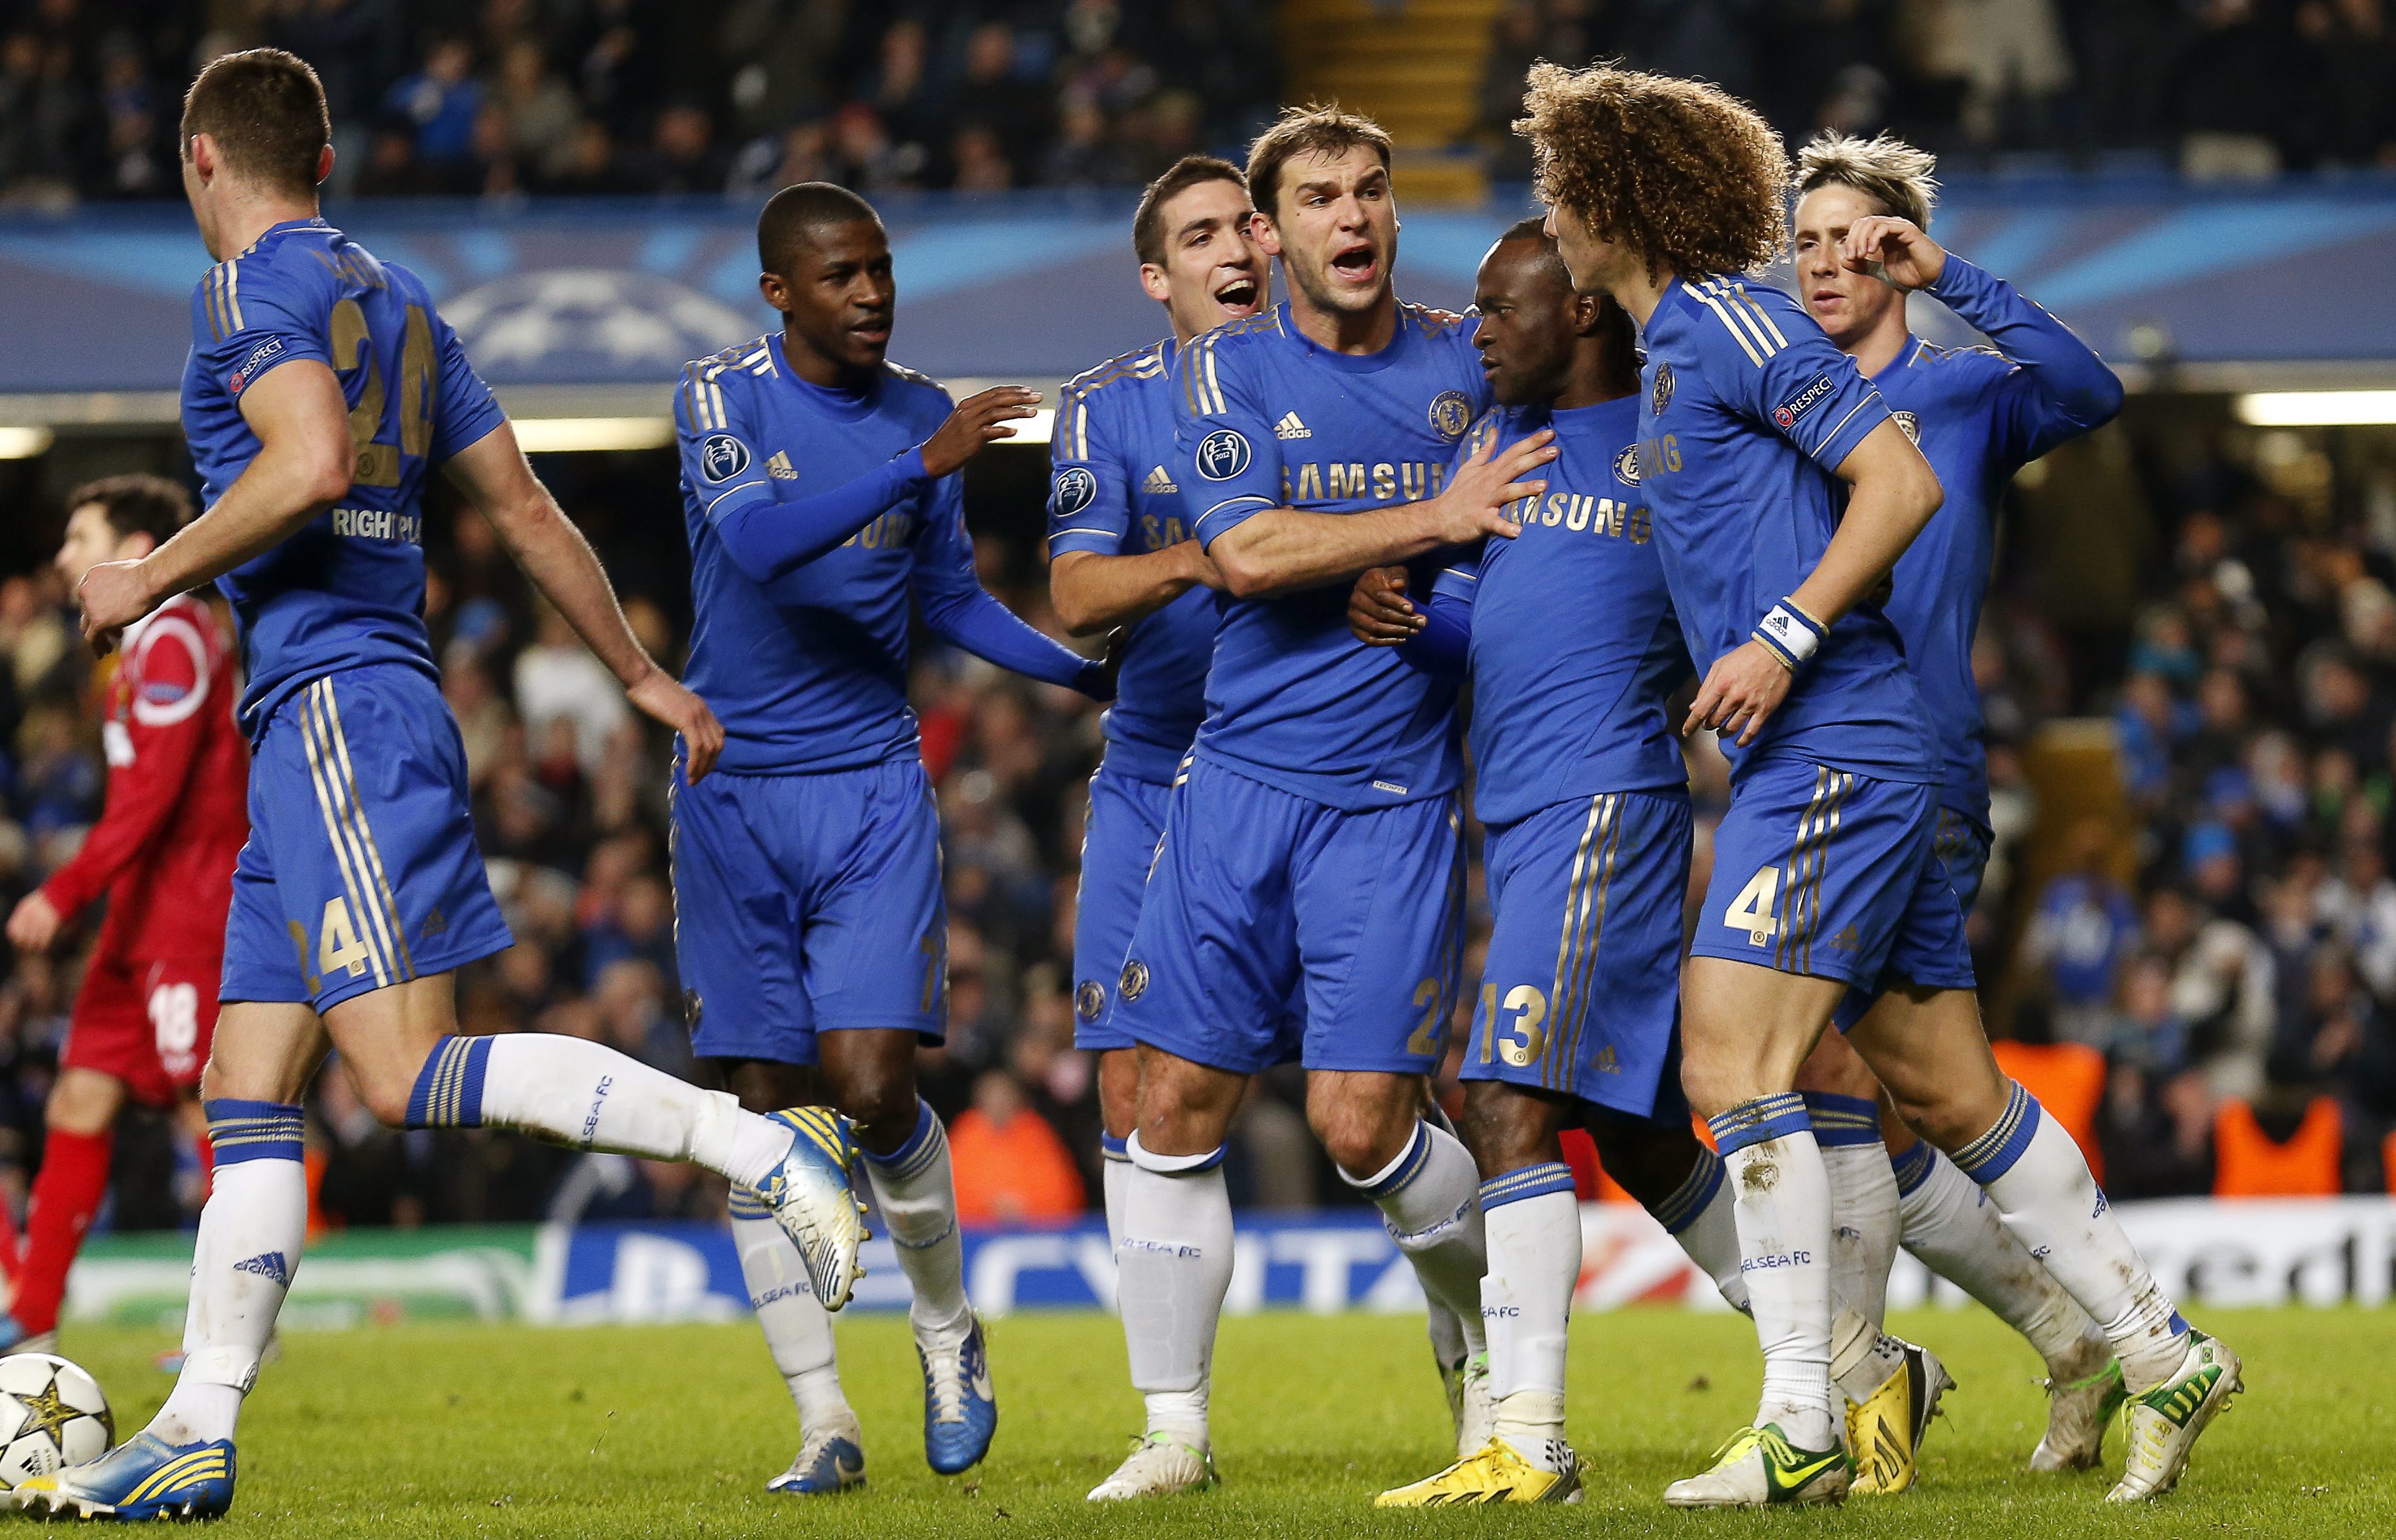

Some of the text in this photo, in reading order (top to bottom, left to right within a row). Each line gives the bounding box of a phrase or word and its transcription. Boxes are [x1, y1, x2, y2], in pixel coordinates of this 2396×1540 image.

[241, 338, 282, 379] RESPECT
[1789, 376, 1833, 415] RESPECT
[1214, 451, 1230, 461] 2012
[1723, 865, 1780, 948] 4
[148, 983, 198, 1053] 18
[1480, 983, 1547, 1068] 13
[596, 1075, 613, 1096] FC
[1179, 1246, 1201, 1257] FC
[1793, 1250, 1811, 1266] FC
[795, 1282, 810, 1296] FC
[1499, 1306, 1520, 1318] FC
